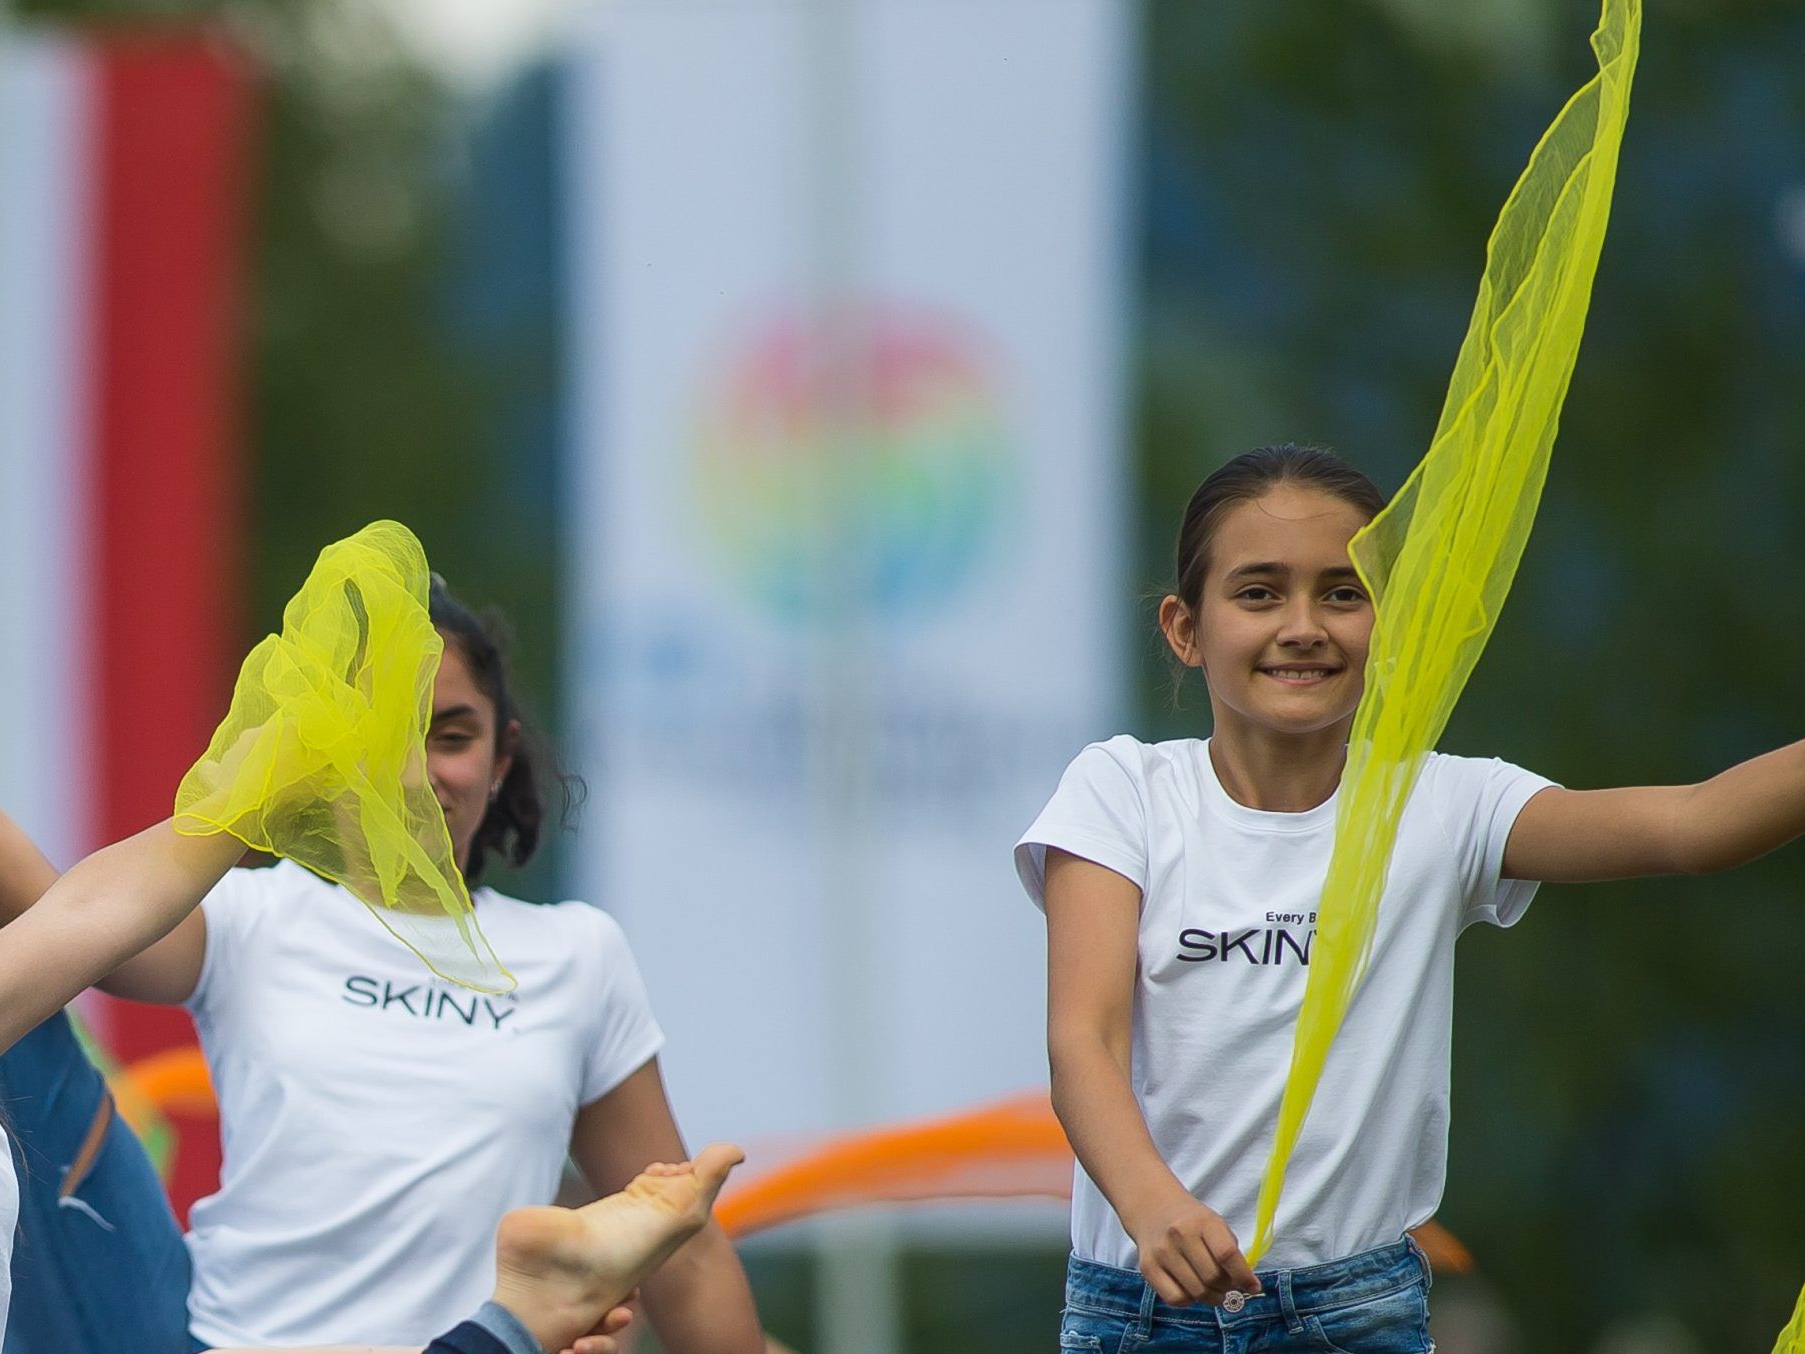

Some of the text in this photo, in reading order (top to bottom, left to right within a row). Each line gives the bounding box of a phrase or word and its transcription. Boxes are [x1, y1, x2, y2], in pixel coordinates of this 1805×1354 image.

[1265, 911, 1305, 925] Every
[1176, 928, 1318, 966] SKIN
[342, 976, 515, 1030] SKINY
